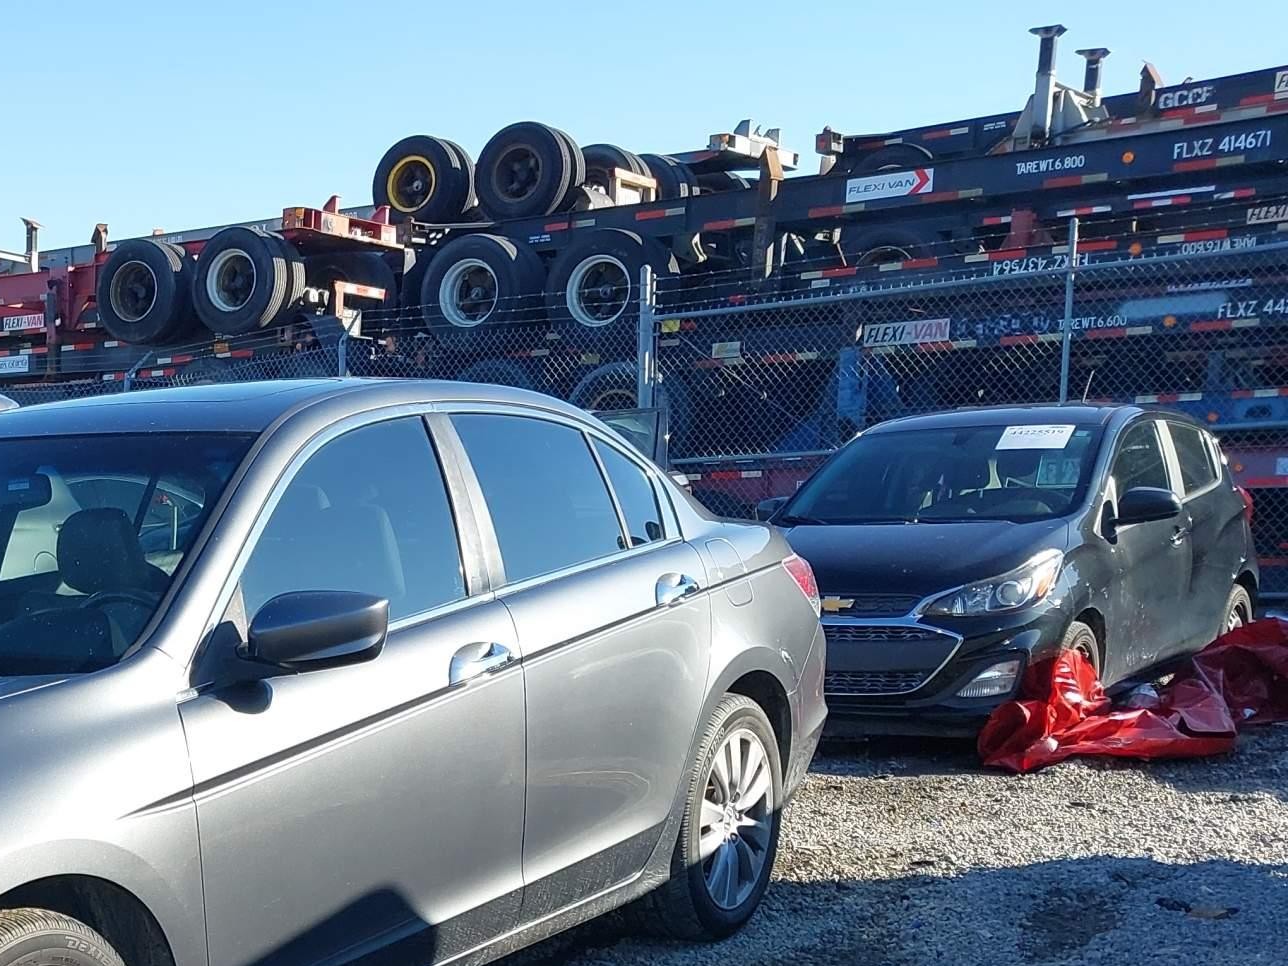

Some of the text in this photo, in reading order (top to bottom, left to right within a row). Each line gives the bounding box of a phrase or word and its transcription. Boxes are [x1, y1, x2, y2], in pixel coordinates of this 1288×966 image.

[1173, 130, 1272, 159] FLXZ 414671
[848, 178, 916, 195] FLEXI VAN
[992, 257, 1047, 276] 437564
[1217, 300, 1258, 319] FLXZ
[865, 321, 949, 344] FLEXI-VAN
